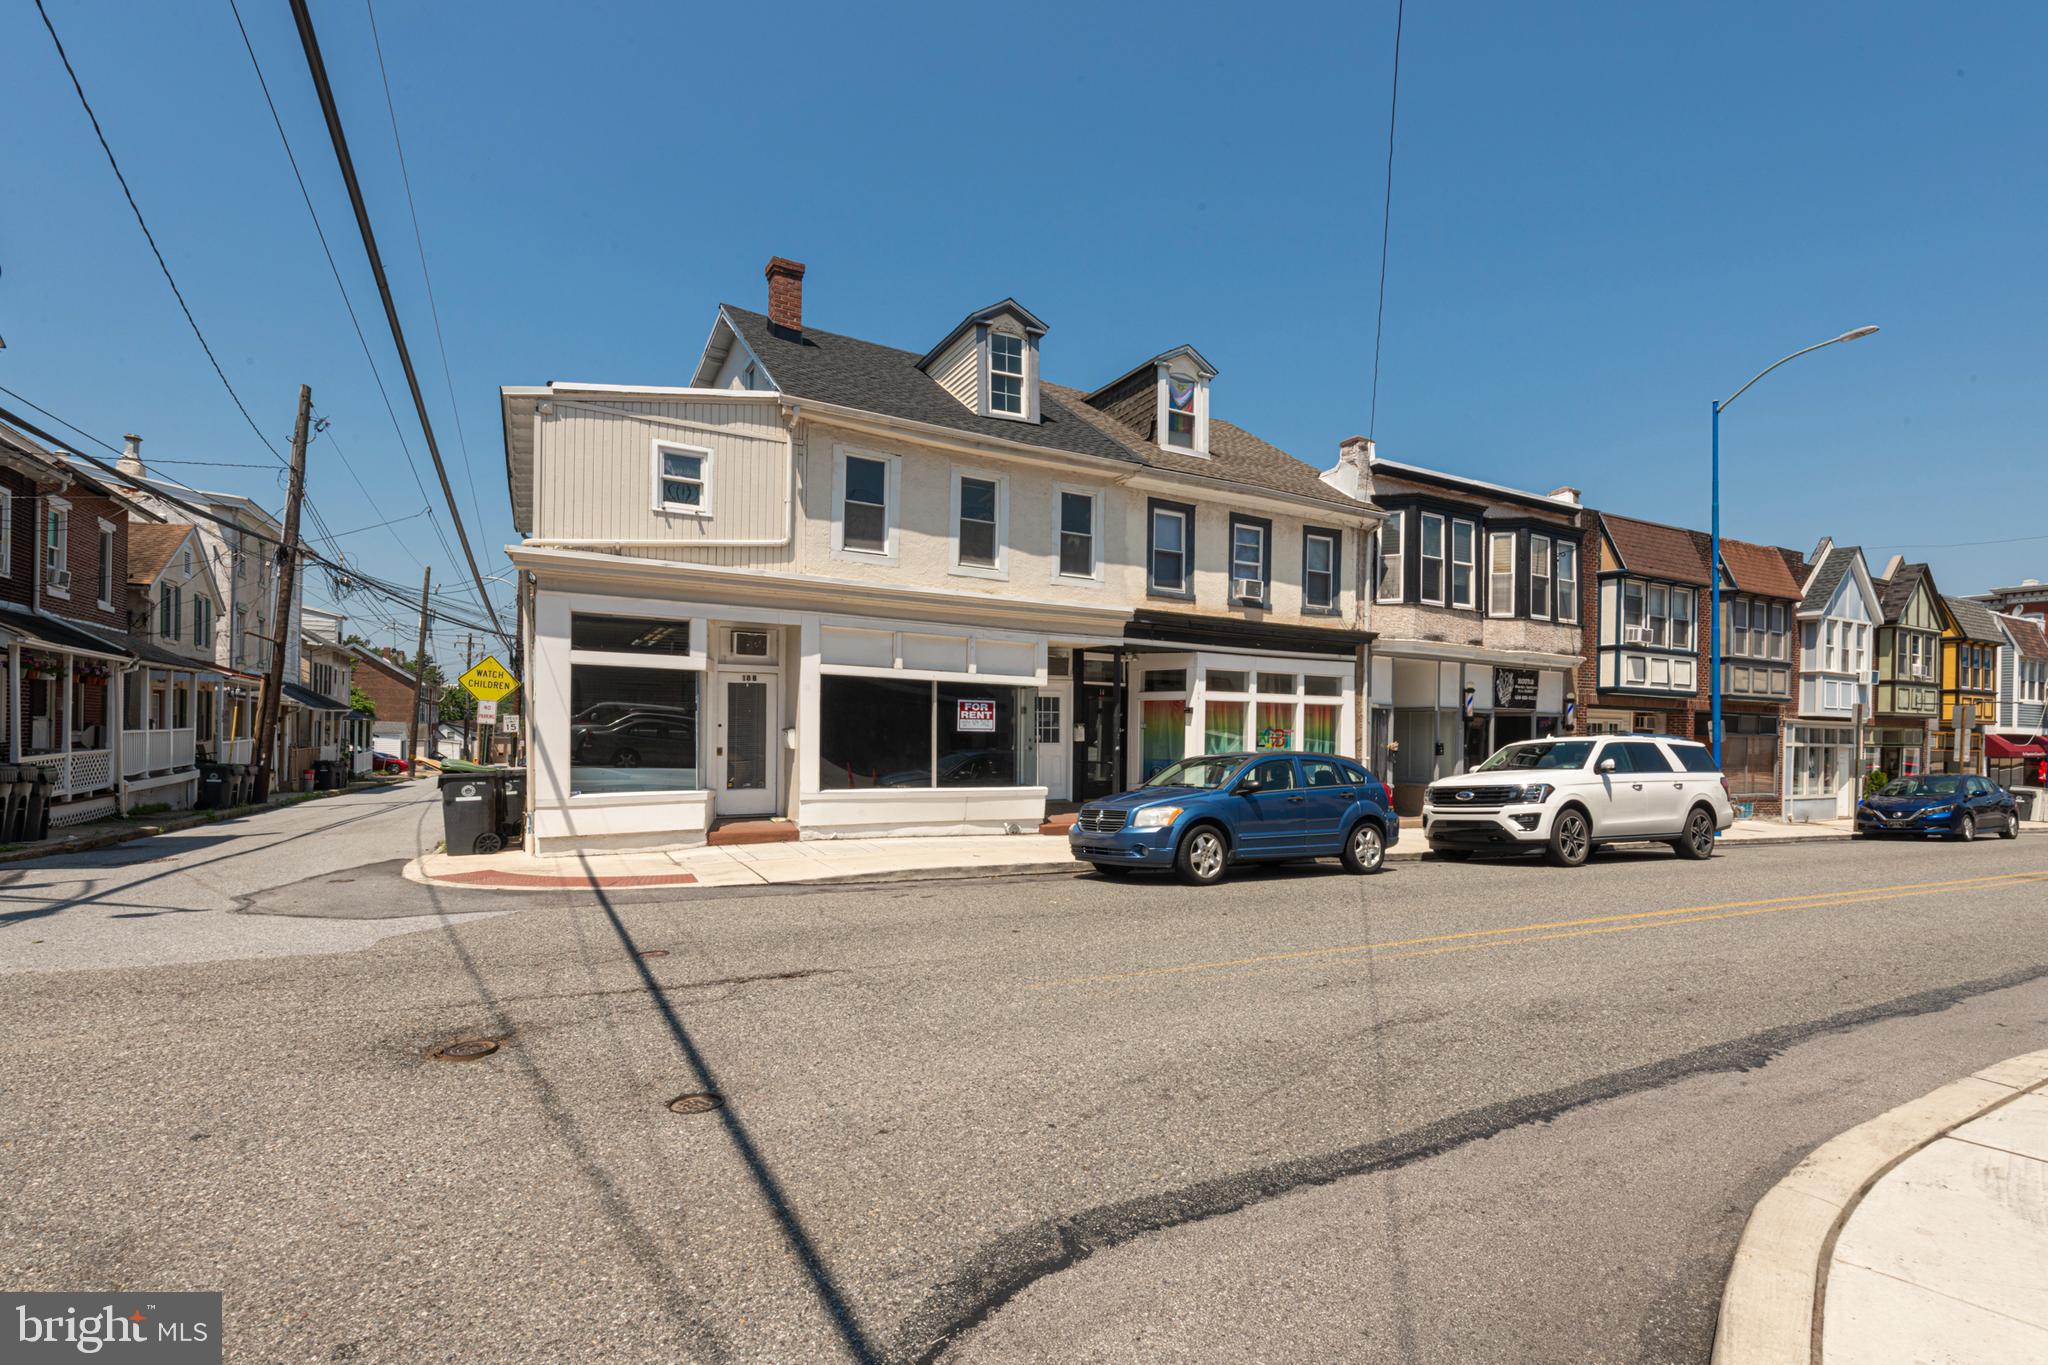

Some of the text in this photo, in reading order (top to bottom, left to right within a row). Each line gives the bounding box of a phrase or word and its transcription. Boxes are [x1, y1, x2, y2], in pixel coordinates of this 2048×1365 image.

[476, 669, 504, 679] WATCH
[468, 679, 510, 690] CHILDREN
[964, 703, 988, 711] FOR
[960, 711, 992, 719] RENT
[506, 723, 517, 731] 15
